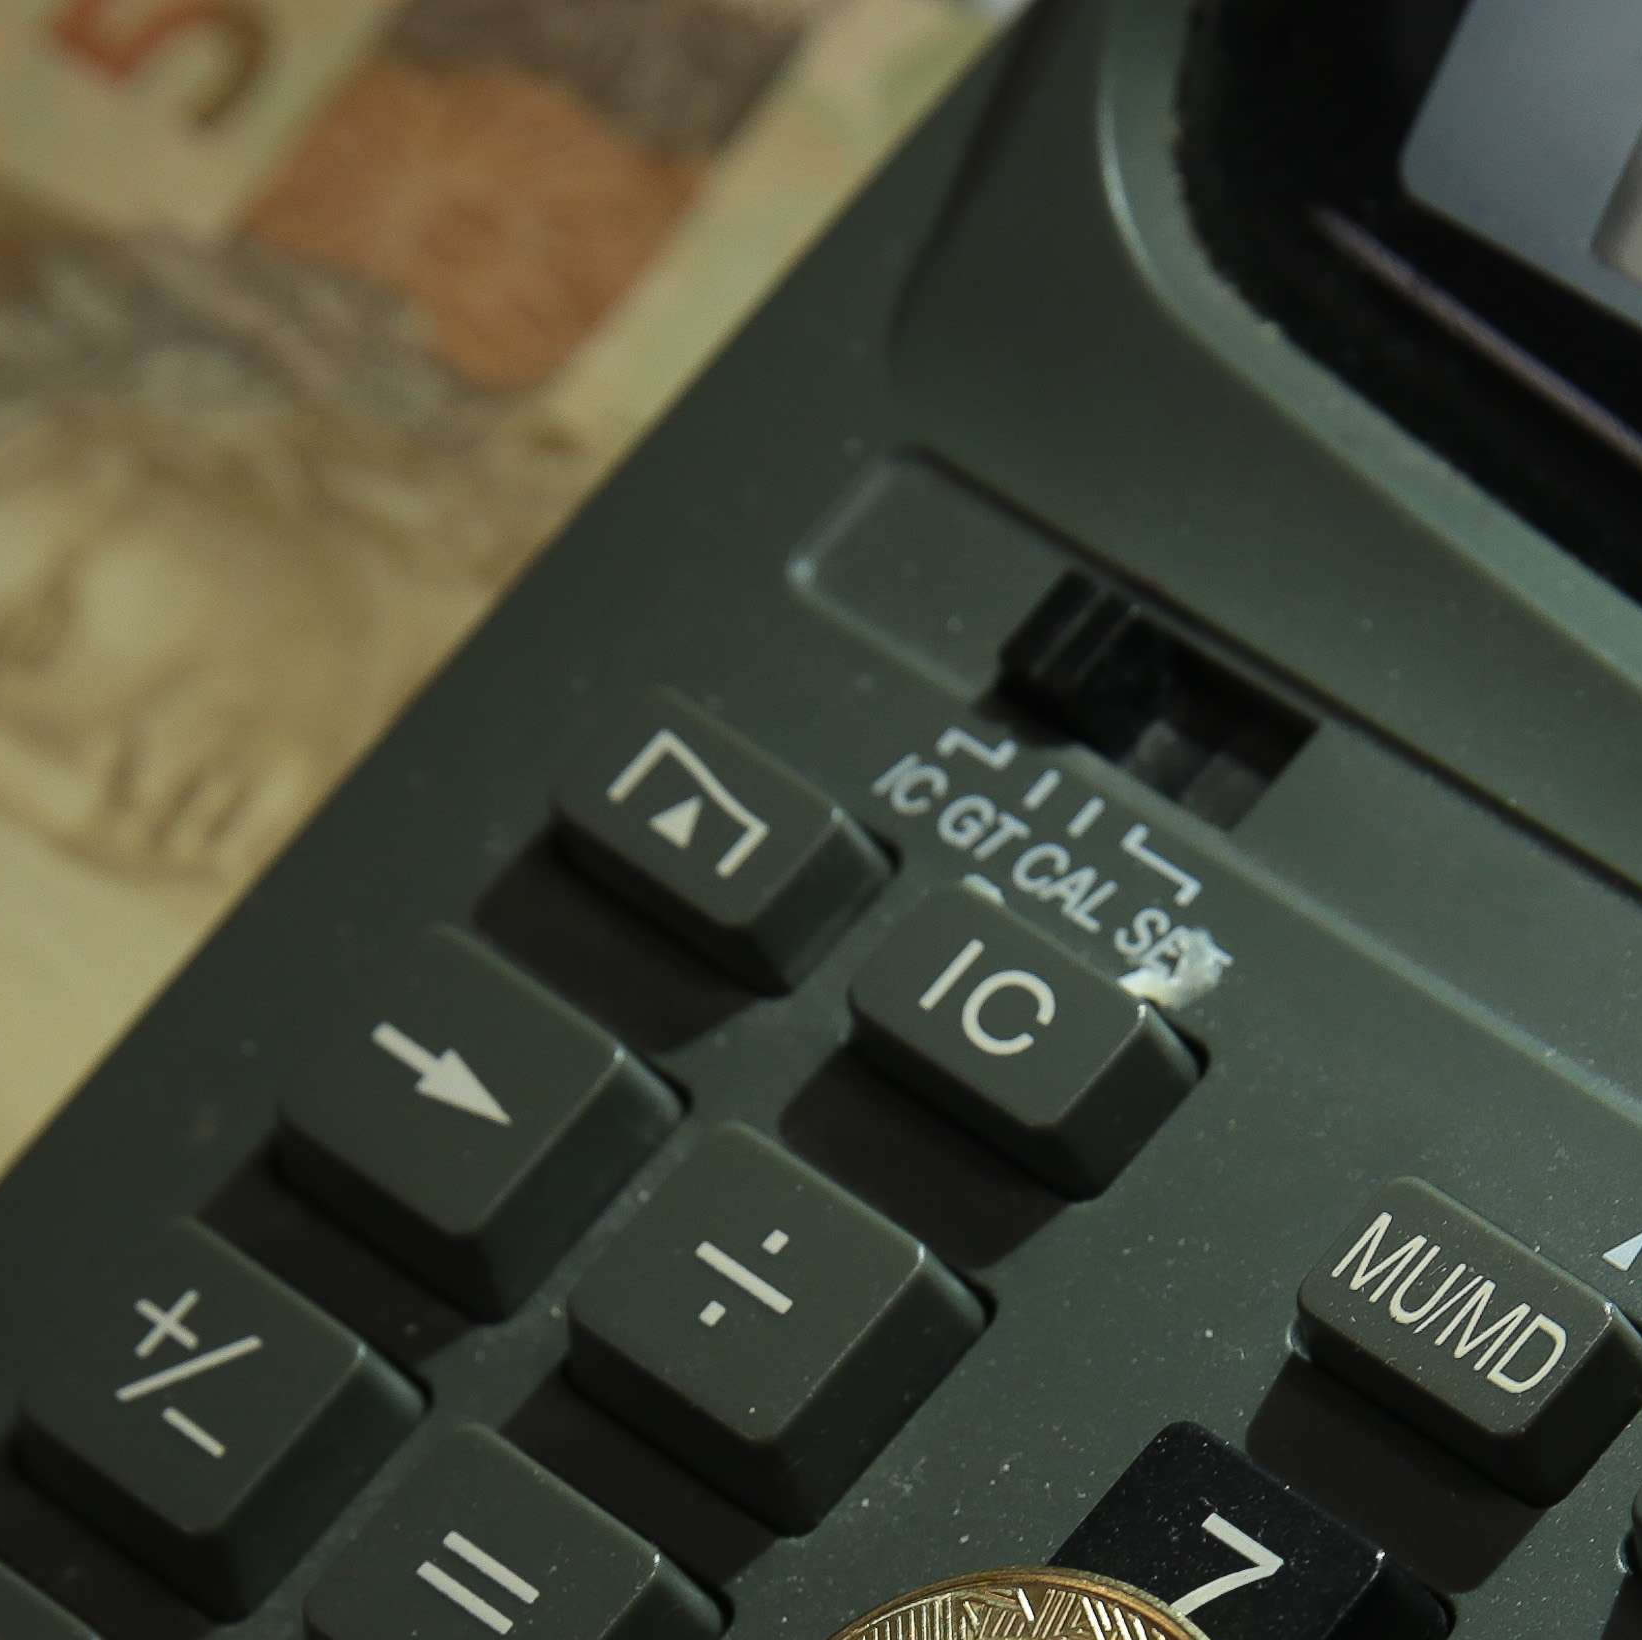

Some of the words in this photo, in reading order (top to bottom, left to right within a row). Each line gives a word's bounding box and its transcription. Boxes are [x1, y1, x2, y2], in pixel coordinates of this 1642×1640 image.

[871, 752, 951, 816] IC
[936, 794, 1032, 861] GT
[1011, 841, 1120, 934] CAL
[919, 939, 1056, 1055] IC
[1331, 1211, 1567, 1394] MU/MD
[1169, 1511, 1285, 1618] 7
